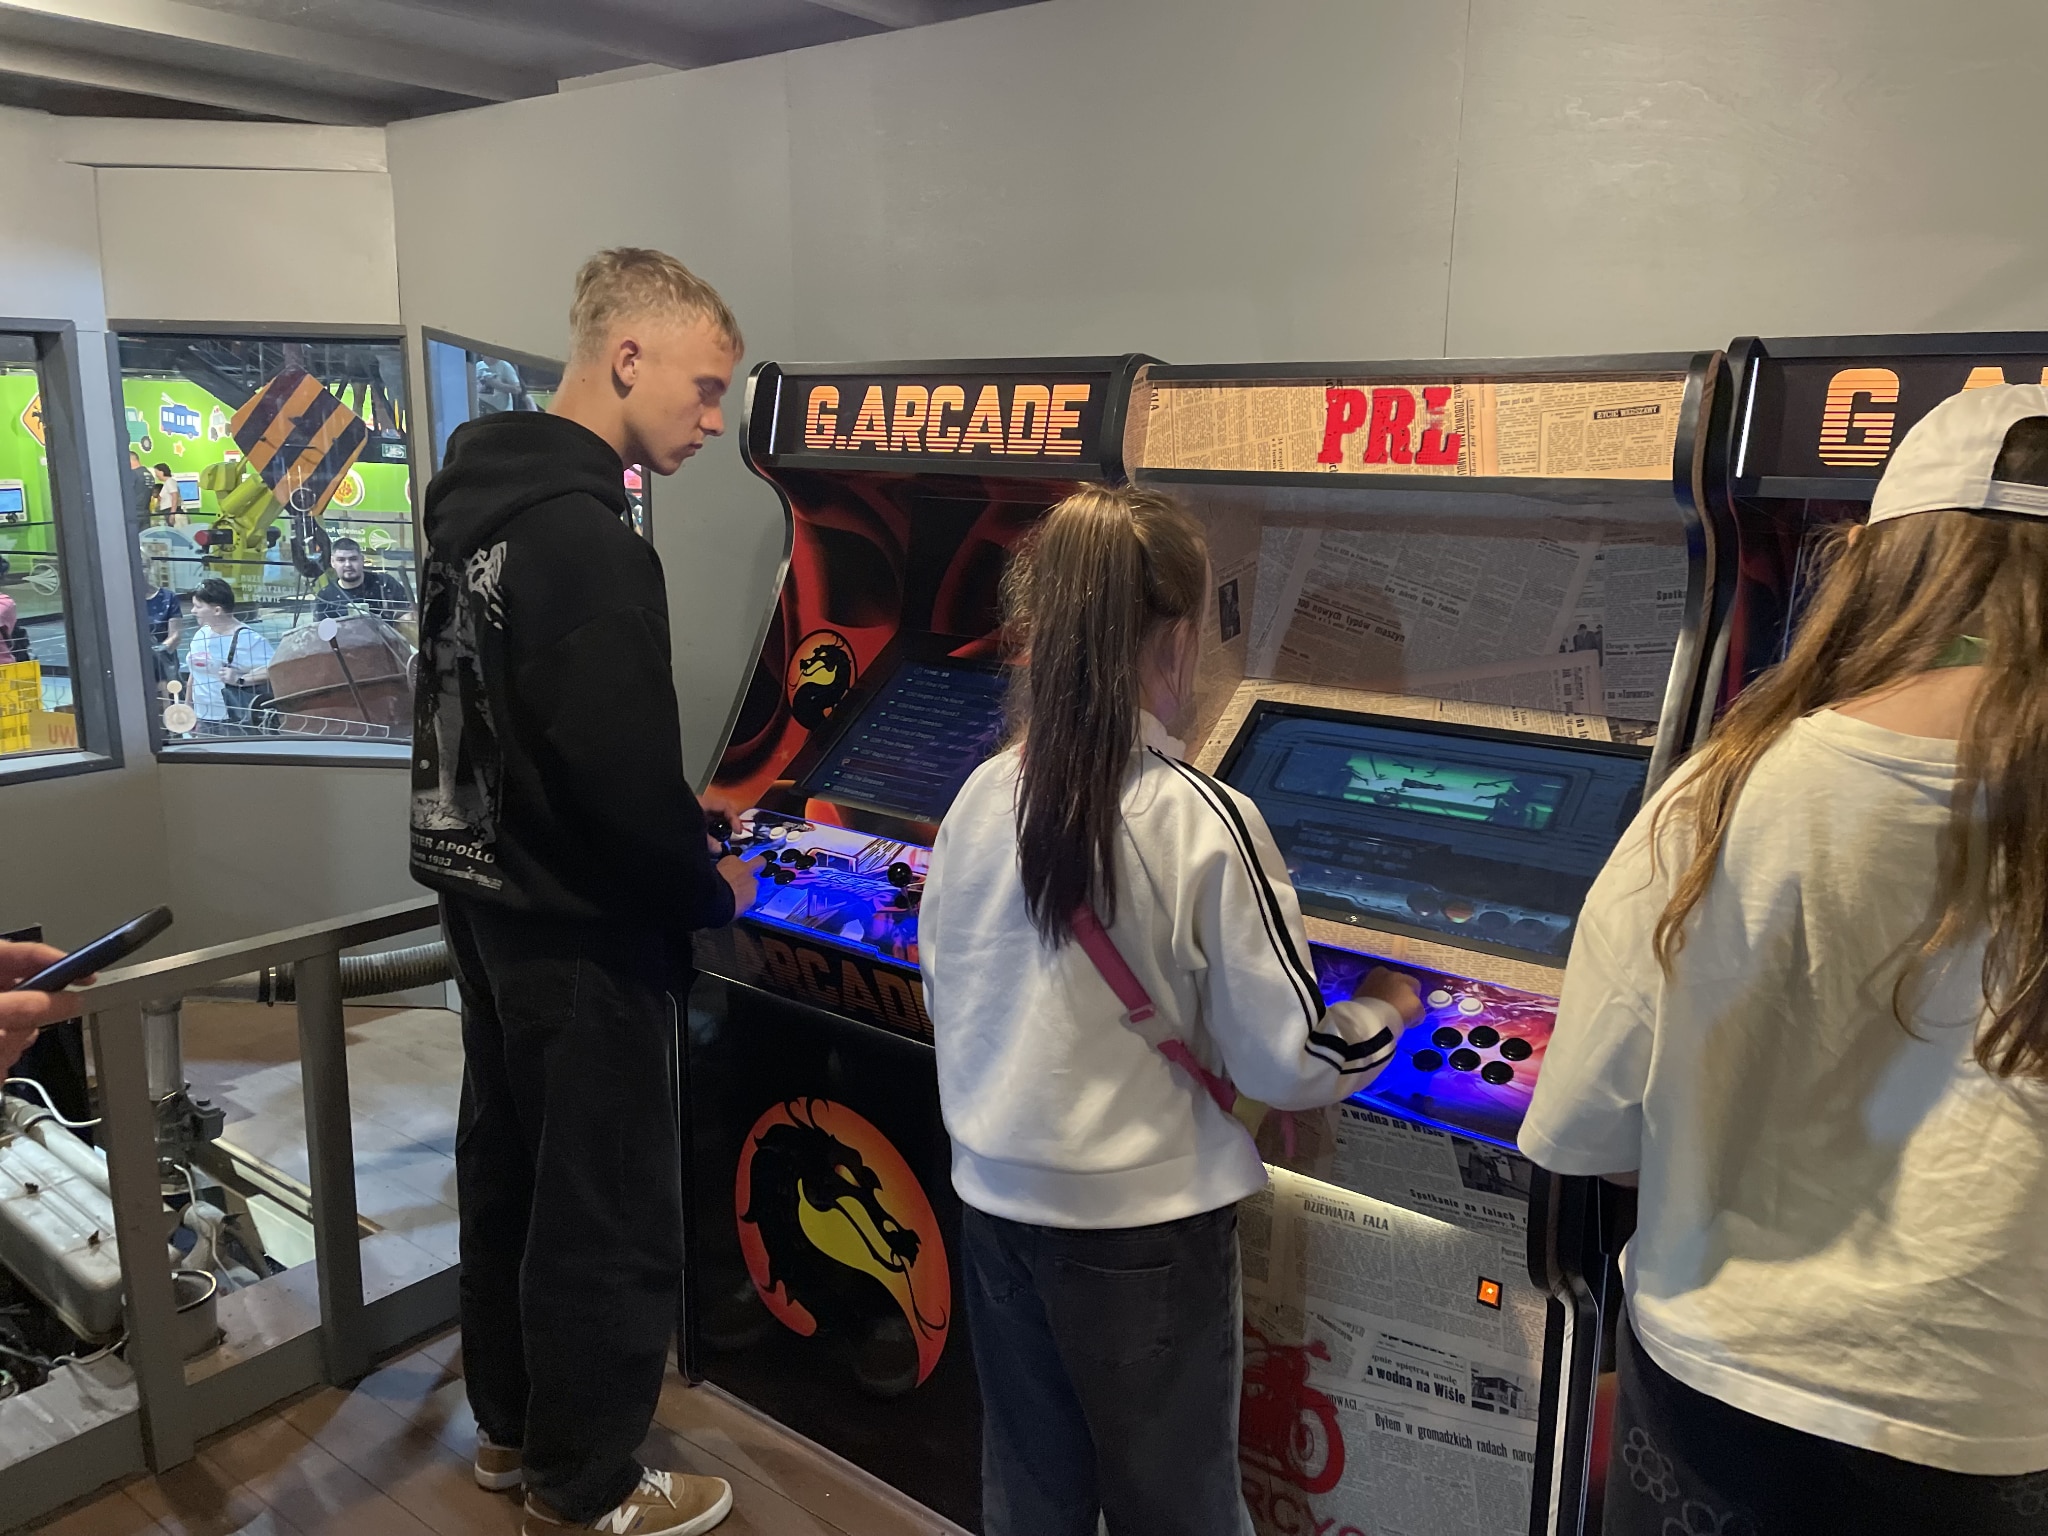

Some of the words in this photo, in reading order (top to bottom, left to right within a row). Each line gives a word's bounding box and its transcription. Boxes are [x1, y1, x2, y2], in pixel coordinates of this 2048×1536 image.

[804, 384, 1091, 456] G.ARCADE
[1317, 386, 1462, 466] PRL
[435, 840, 495, 864] APOLLO
[1350, 1110, 1390, 1127] wodna
[1392, 1119, 1409, 1130] na
[1409, 1188, 1460, 1208] Spotkanie
[1362, 1214, 1389, 1231] FALA
[1376, 1367, 1413, 1388] wodna
[1416, 1380, 1430, 1394] na
[1433, 1382, 1466, 1404] Wiśle
[1375, 1412, 1401, 1432] Byłem
[1405, 1423, 1413, 1435] w
[1417, 1426, 1473, 1450] gromadzkich
[1477, 1440, 1508, 1458] radach
